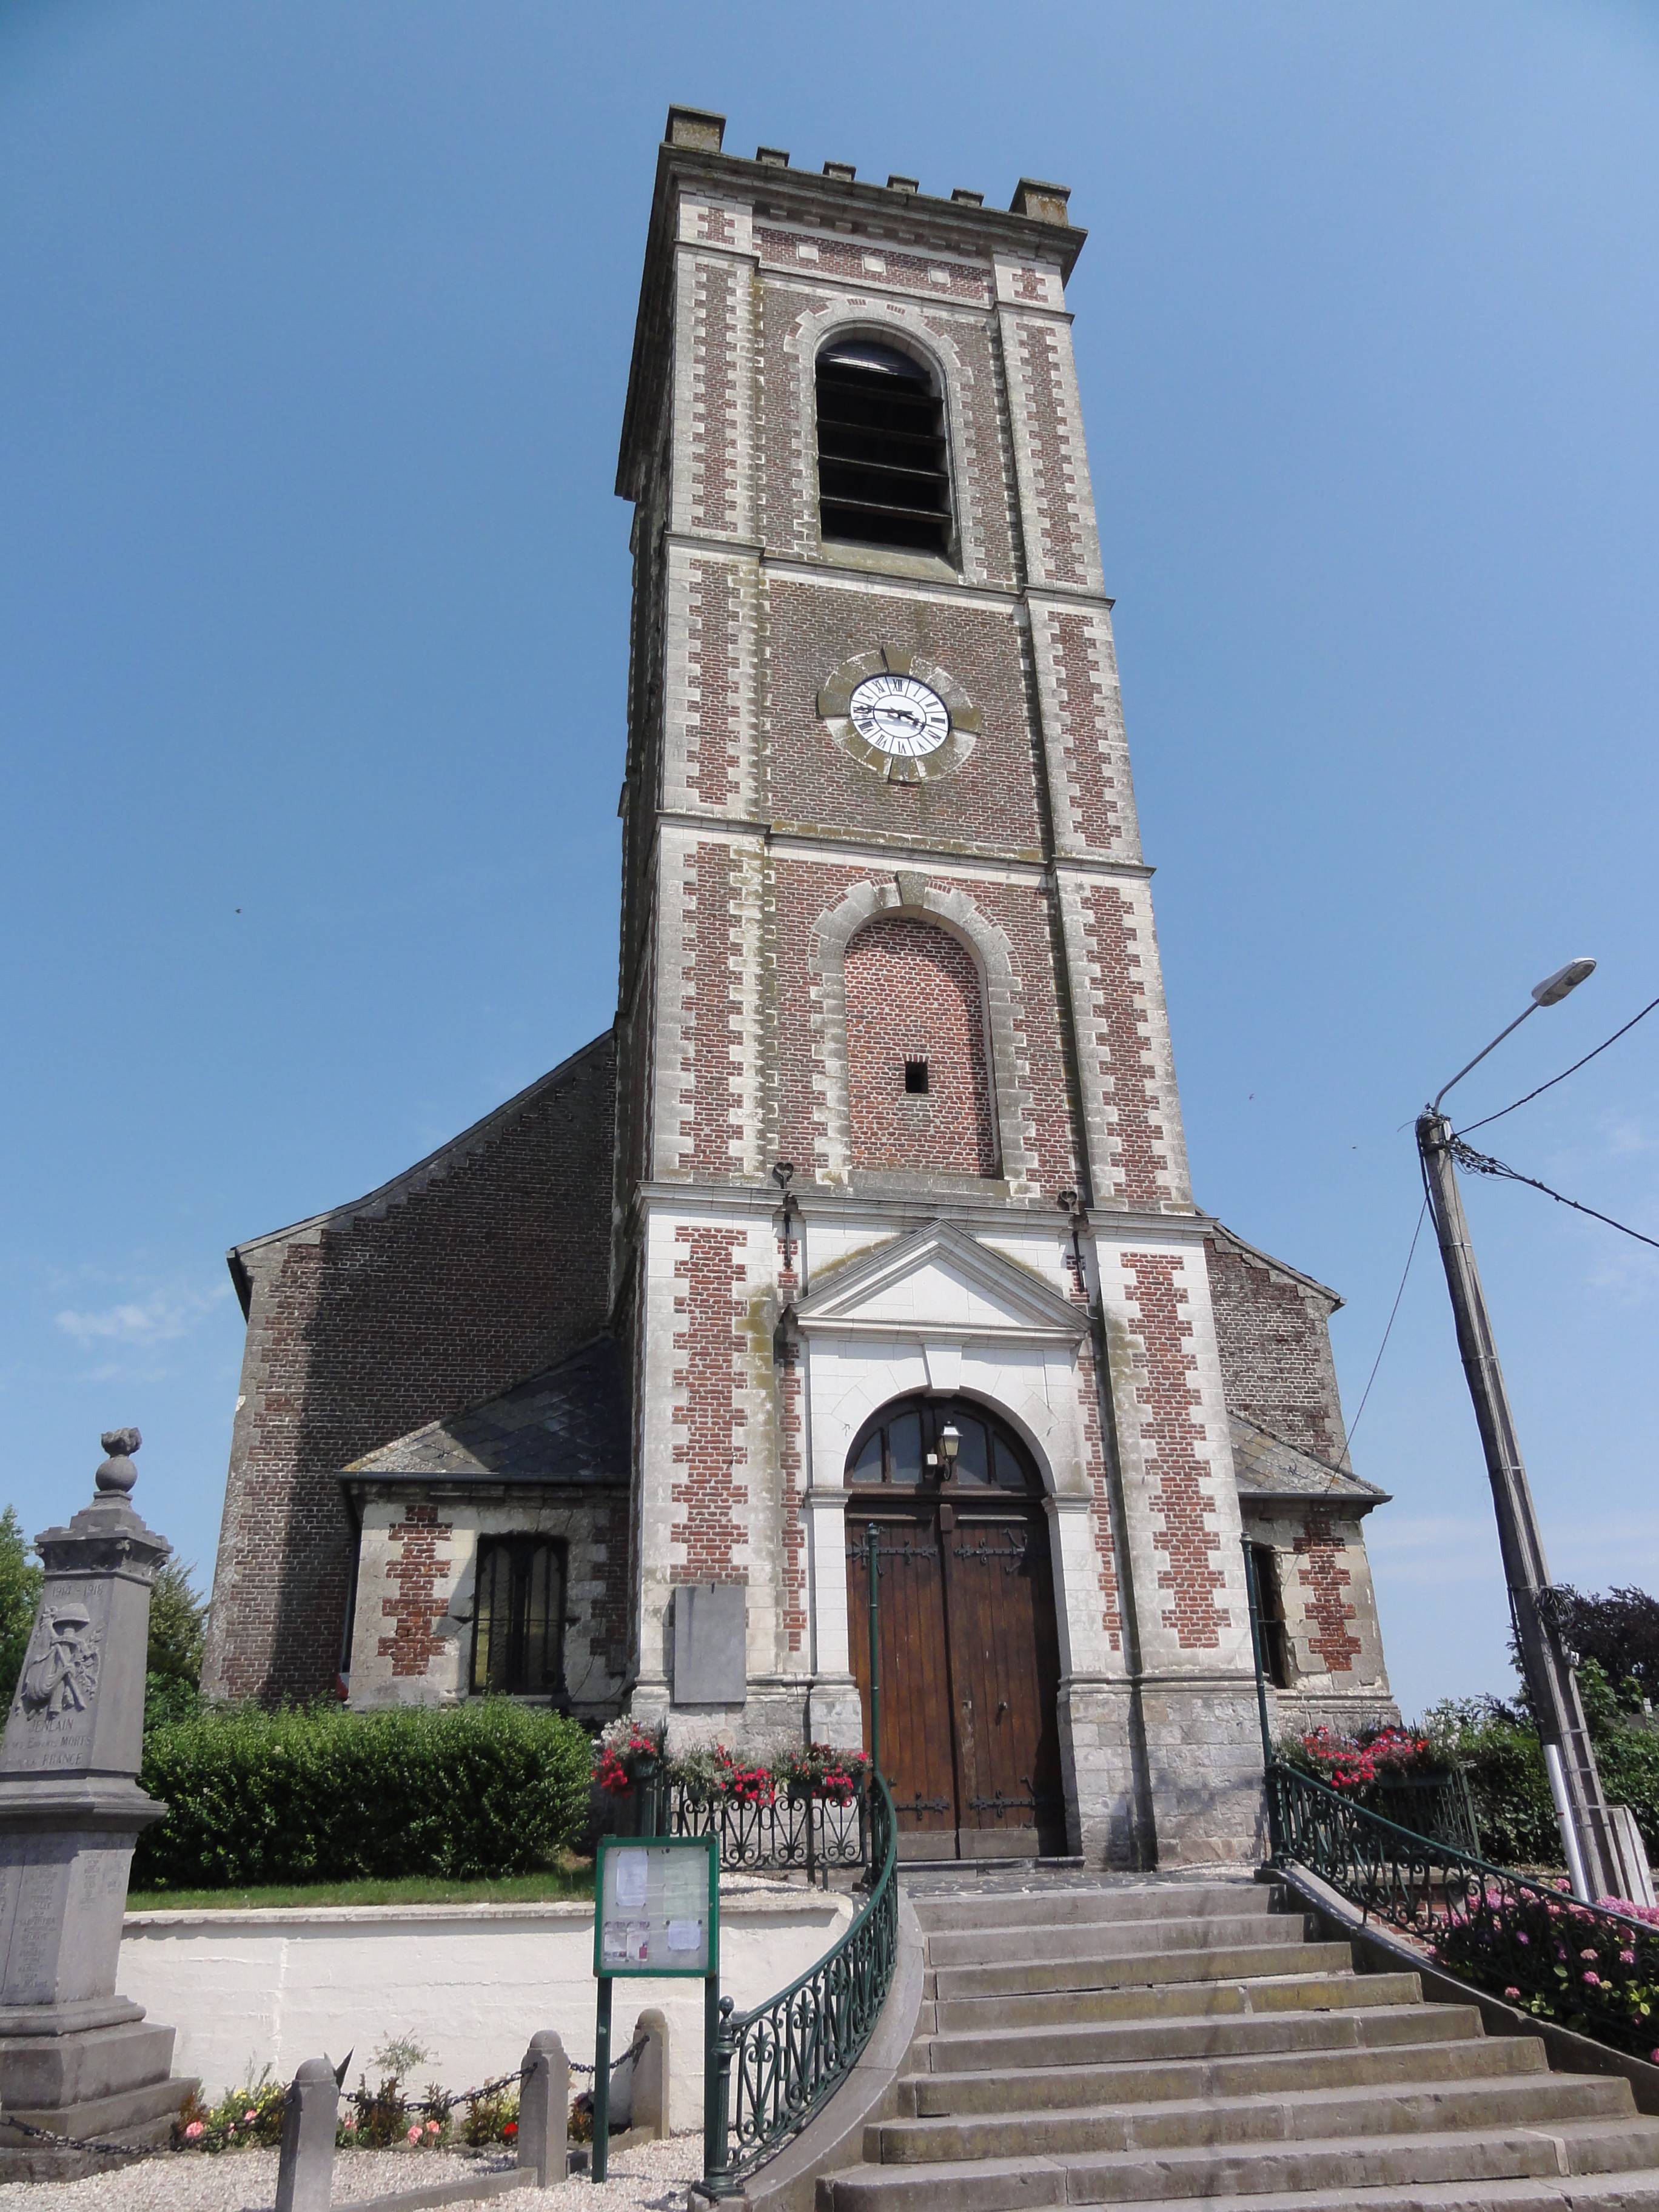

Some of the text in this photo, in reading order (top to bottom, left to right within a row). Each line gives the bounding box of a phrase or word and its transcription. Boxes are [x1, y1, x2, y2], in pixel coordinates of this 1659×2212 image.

[872, 679, 885, 694] XI
[893, 679, 902, 692] XII
[914, 686, 922, 697] I
[858, 691, 873, 702] X
[897, 741, 907, 754] VI
[917, 740, 927, 752] V
[52, 1585, 72, 1597] 1914
[83, 1584, 104, 1597] 1918
[28, 1718, 74, 1733] JENLAIN
[61, 1735, 91, 1747] MORTS
[41, 1752, 82, 1766] FRANCE
